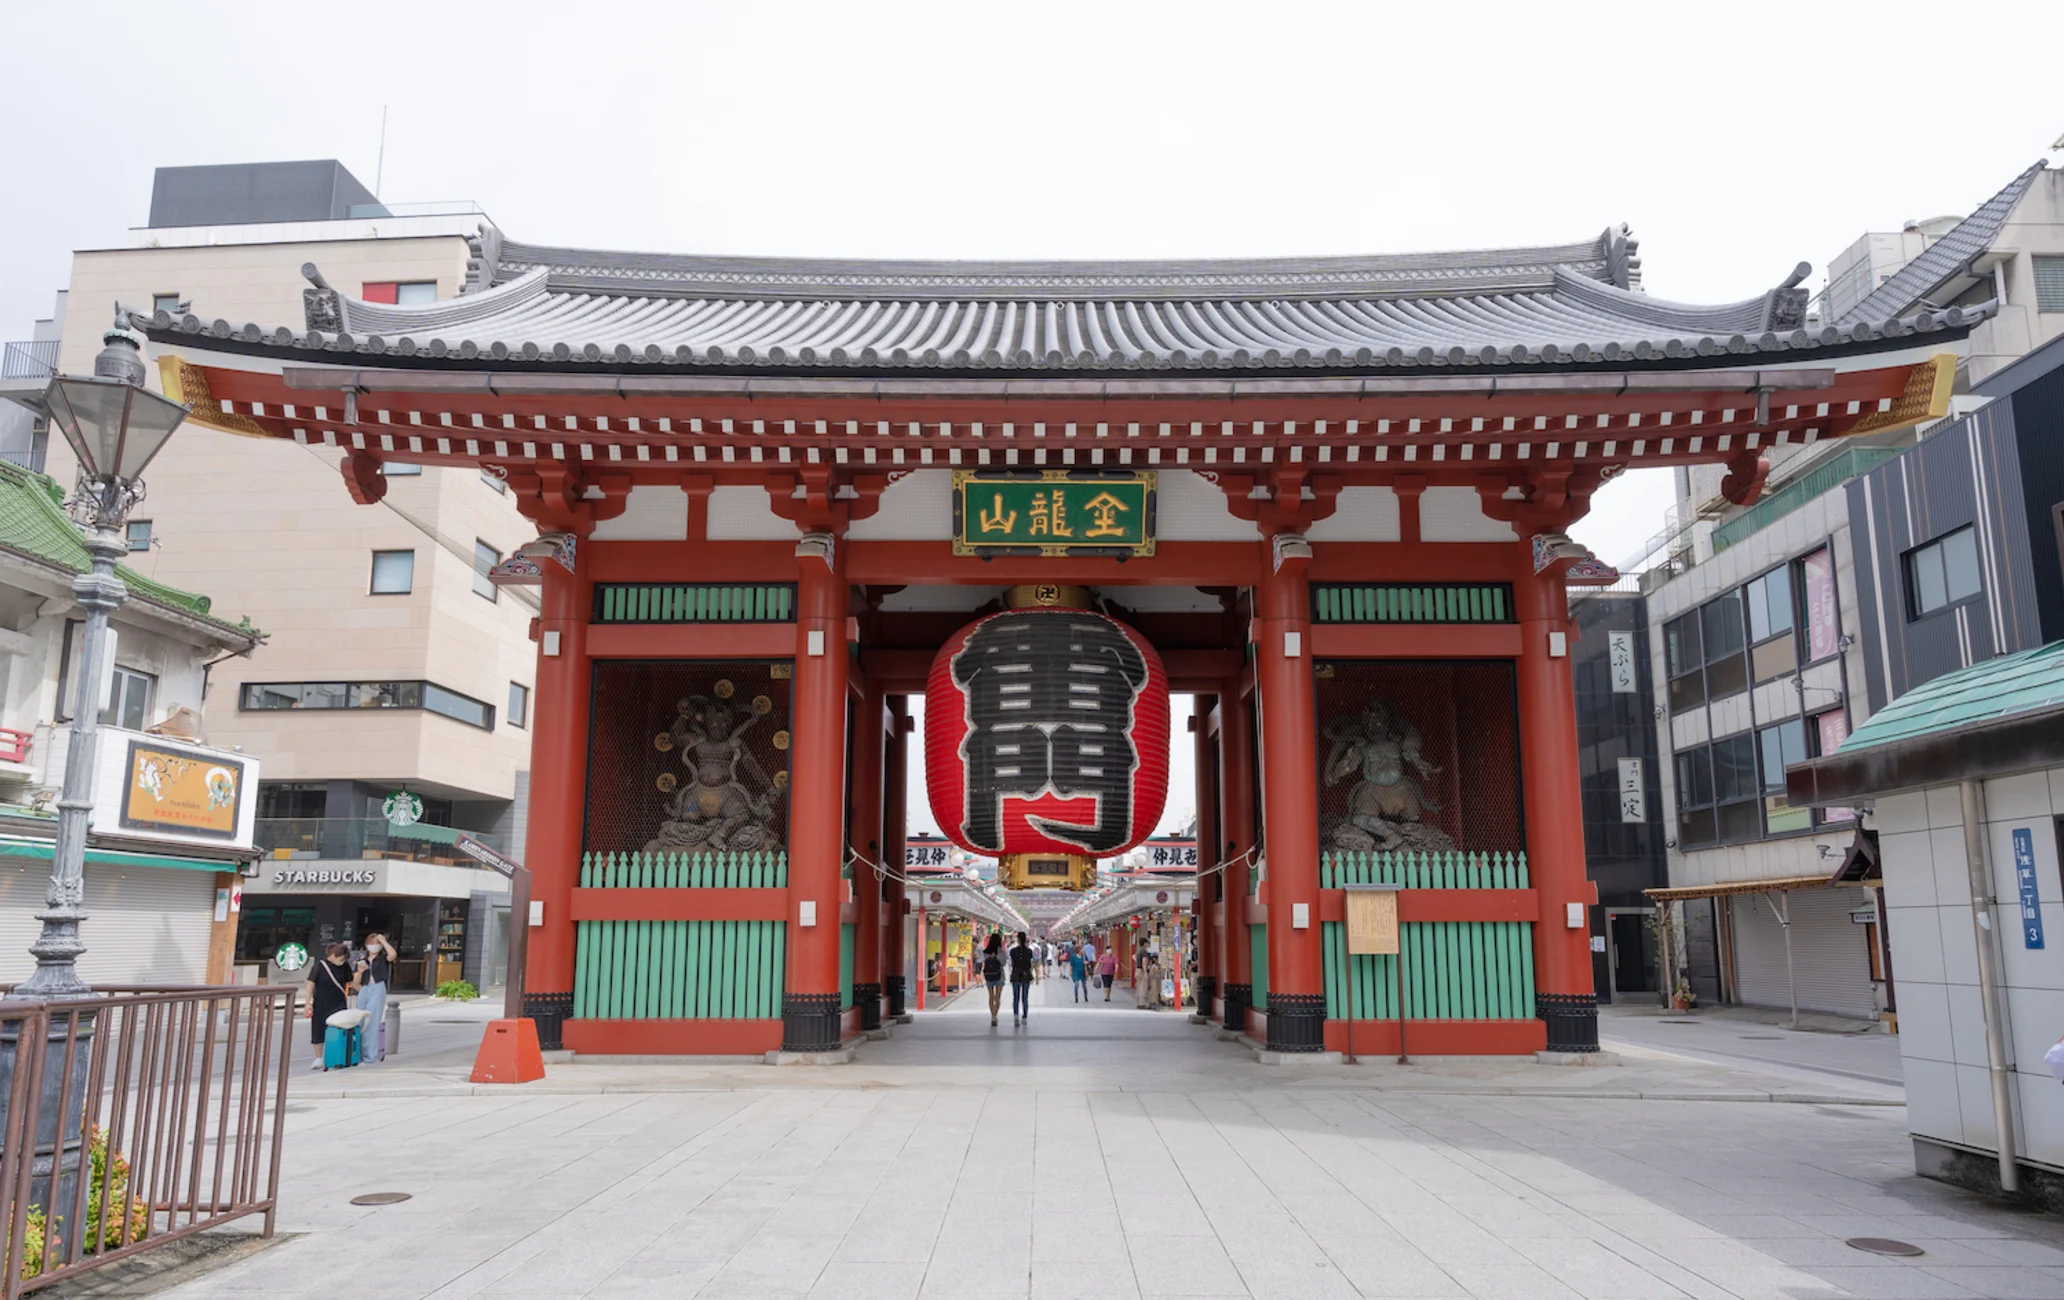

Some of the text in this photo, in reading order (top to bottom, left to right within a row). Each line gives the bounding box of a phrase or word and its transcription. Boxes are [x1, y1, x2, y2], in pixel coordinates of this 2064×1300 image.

[1612, 637, 1630, 687] 天ぷら
[274, 870, 376, 884] STARBUCKS
[2029, 927, 2038, 942] 3
